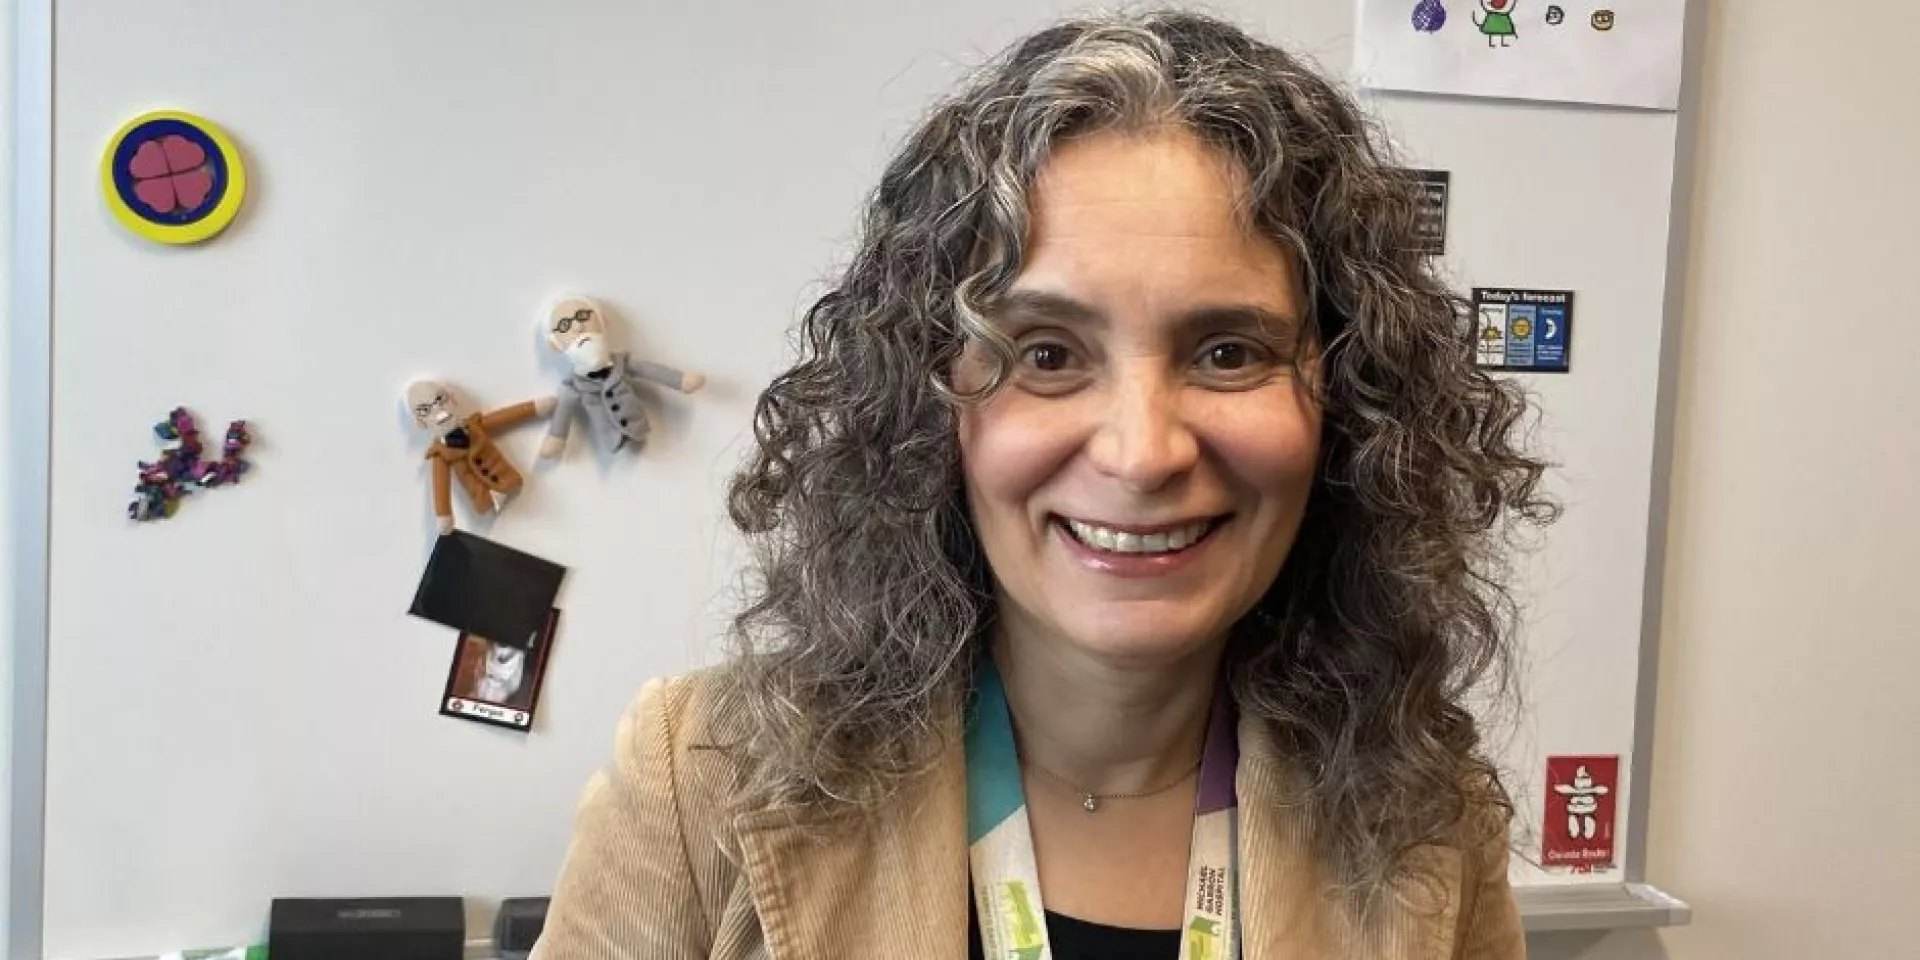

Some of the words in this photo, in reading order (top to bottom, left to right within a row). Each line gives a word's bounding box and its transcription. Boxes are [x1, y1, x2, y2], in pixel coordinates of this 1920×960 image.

[1481, 291, 1520, 303] Today's
[1523, 291, 1566, 303] forecast
[1196, 864, 1207, 910] MICHAEL
